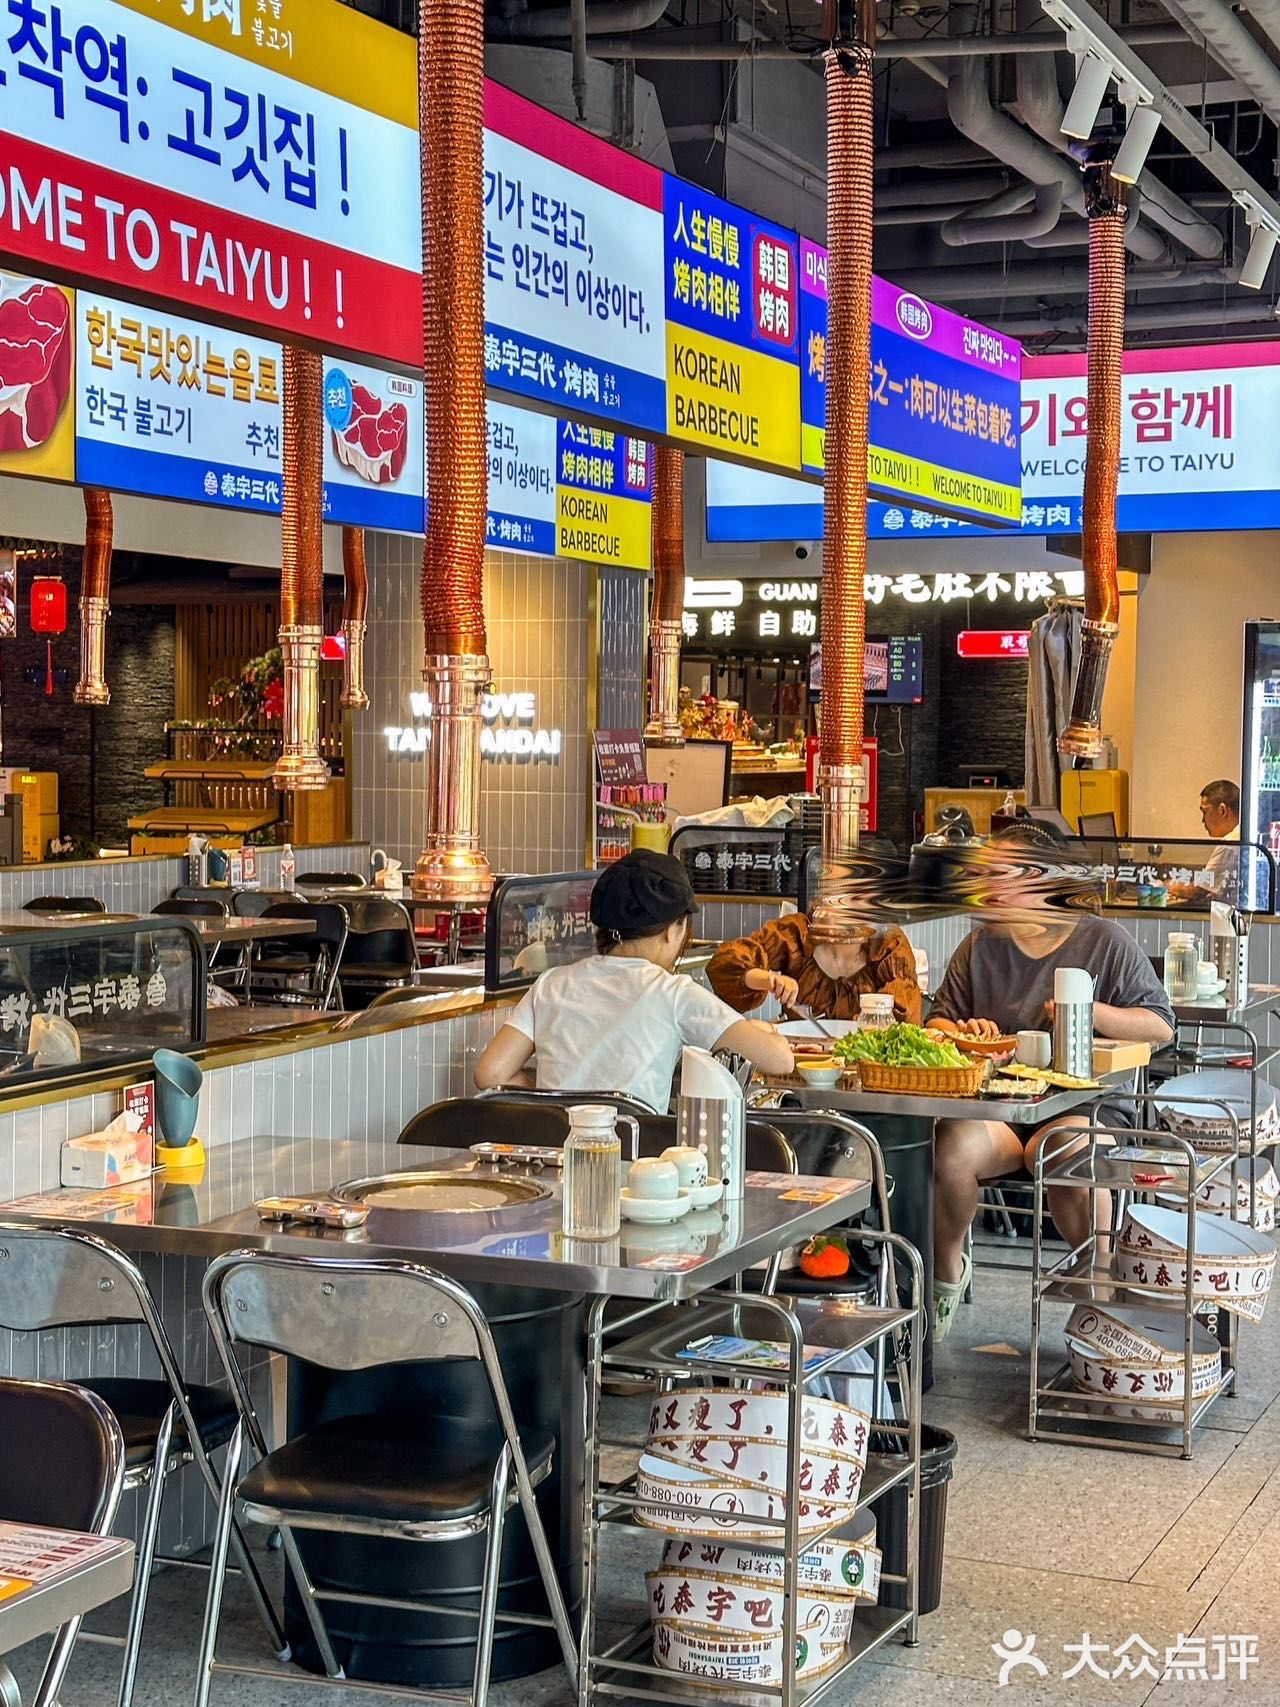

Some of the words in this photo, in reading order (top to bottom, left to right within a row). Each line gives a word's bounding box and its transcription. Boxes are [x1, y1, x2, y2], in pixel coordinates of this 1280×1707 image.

[251, 17, 293, 60] 불고기
[0, 166, 86, 252] ME
[95, 195, 160, 271] TO
[530, 191, 595, 263] 뜨겁고,
[672, 201, 741, 270] 人生慢慢
[512, 243, 569, 306] 인간의
[576, 270, 651, 334] 이상이다.
[672, 257, 741, 322] 烤肉相伴
[758, 240, 790, 291] 韩国
[758, 288, 790, 337] 烤肉
[86, 306, 281, 405] 한국맛있는음료
[673, 342, 742, 395] KOREAN
[86, 384, 128, 431] 한국
[133, 396, 192, 444] 불고기
[244, 421, 280, 460] 추천
[327, 387, 347, 409] 추천
[674, 394, 760, 447] BARBECUE
[1128, 384, 1233, 443] 함께
[507, 460, 554, 494] 이상이다.
[561, 449, 614, 490] 烤肉相伴
[1134, 455, 1165, 473] TO
[1170, 452, 1235, 471] TAIYU
[560, 494, 608, 524] KOREAN
[932, 472, 971, 502] WELCOME
[973, 484, 982, 504] TO
[560, 527, 621, 557] BARBECUE
[758, 583, 818, 602] GUAN
[758, 610, 817, 637] 自助
